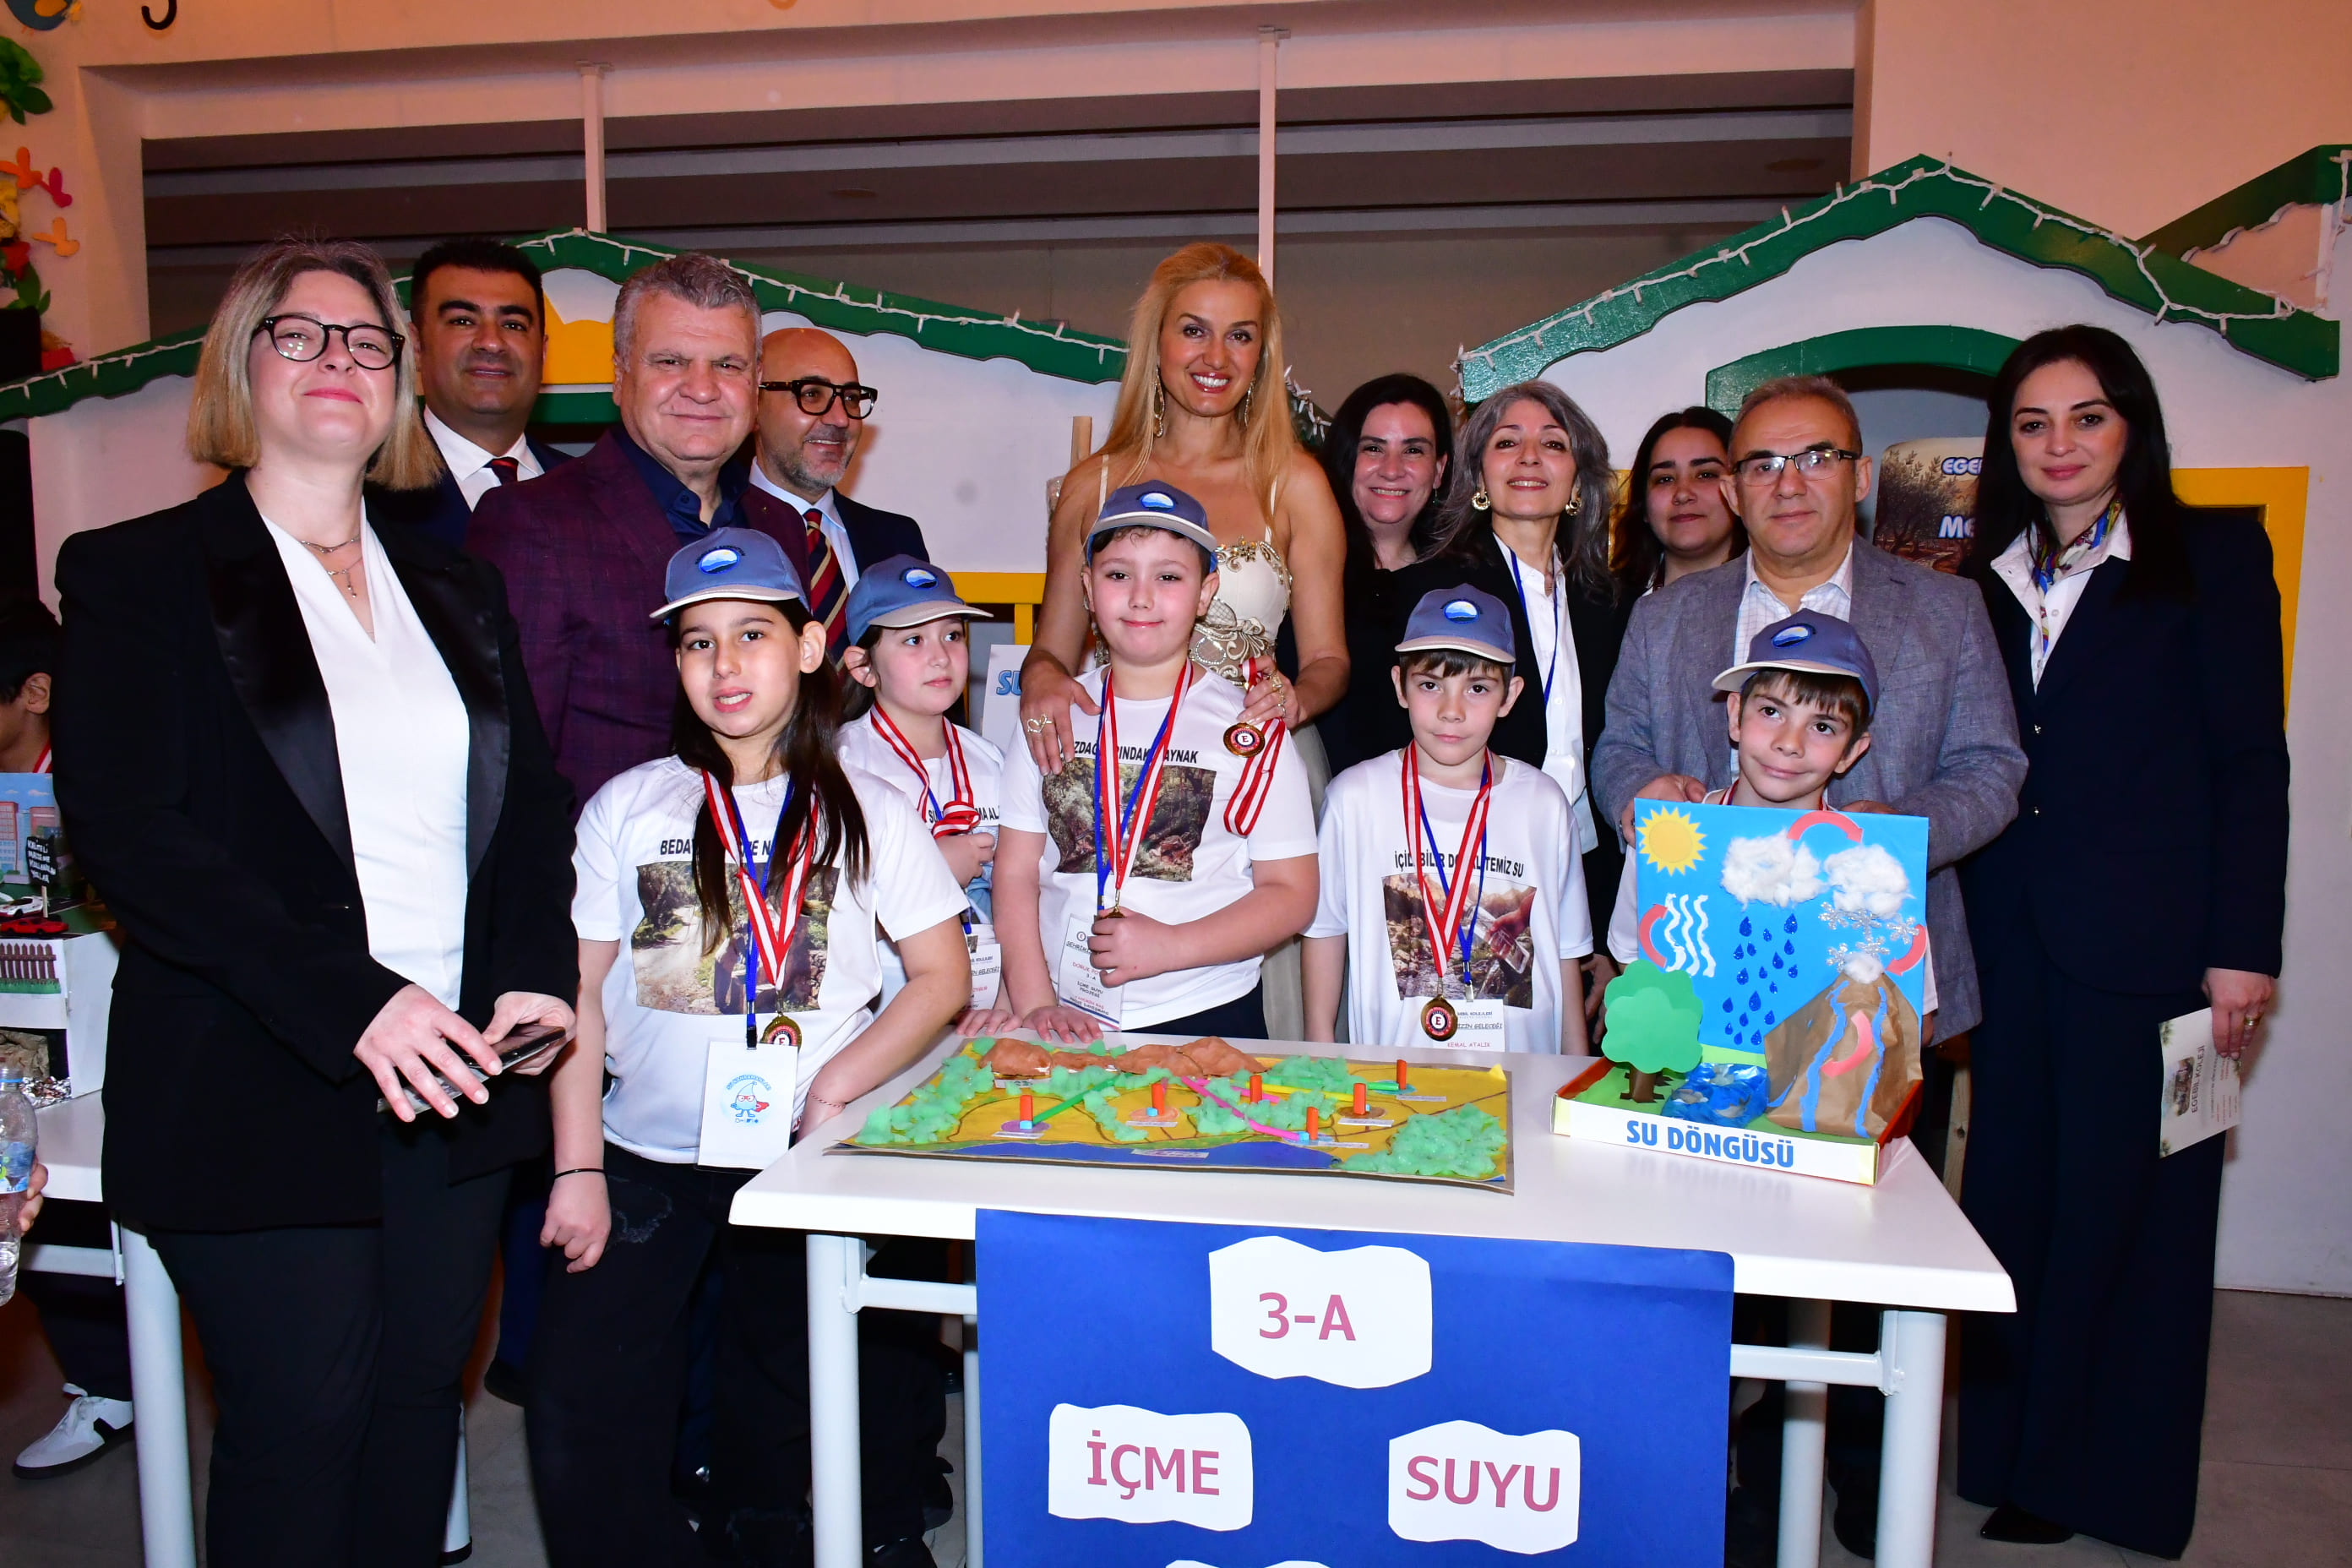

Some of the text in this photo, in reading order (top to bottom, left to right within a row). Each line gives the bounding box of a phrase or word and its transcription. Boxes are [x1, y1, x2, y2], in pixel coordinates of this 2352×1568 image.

[1512, 863, 1524, 878] SU
[1626, 1119, 1794, 1168] SU DÖNGÜSÜ
[1259, 1293, 1356, 1342] 3-A
[1086, 1429, 1221, 1500] İÇME
[1406, 1455, 1561, 1512] SUYU
